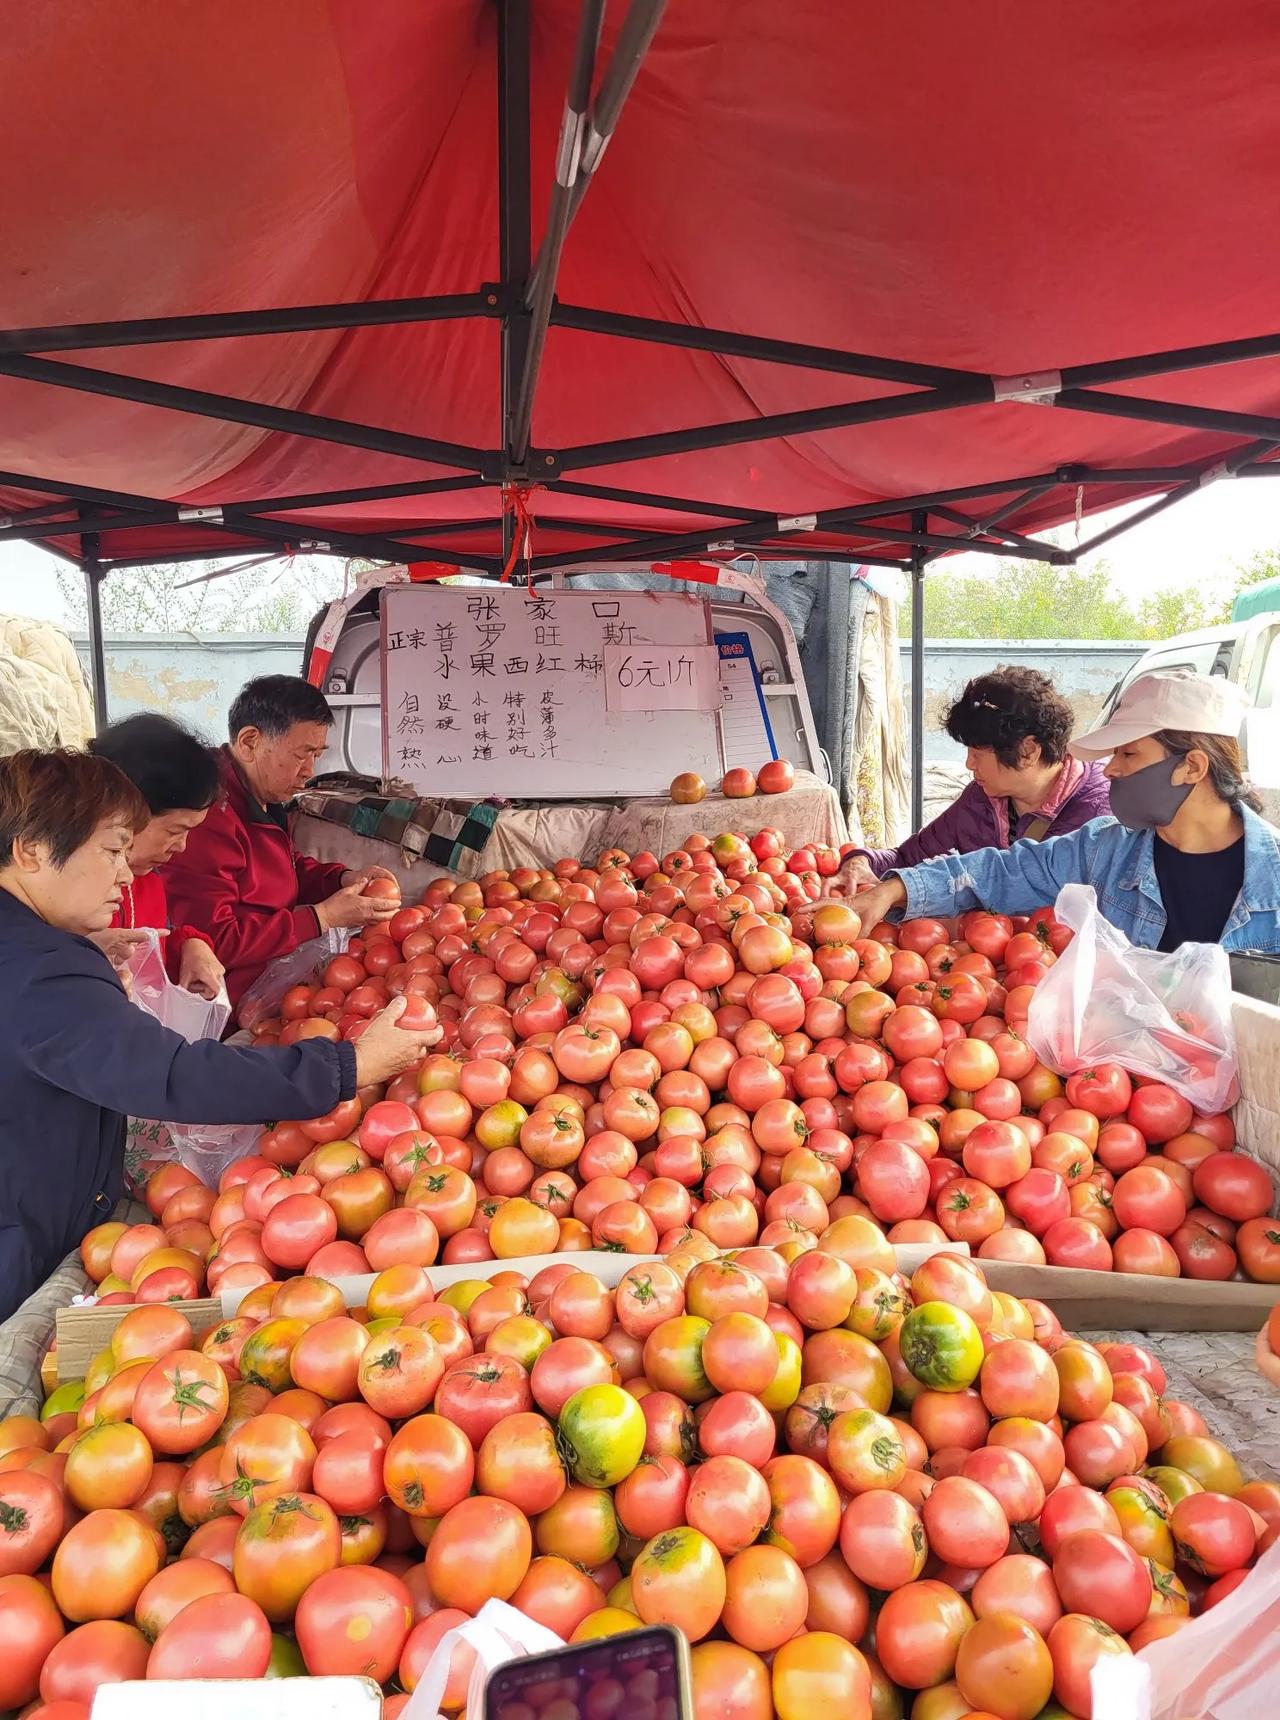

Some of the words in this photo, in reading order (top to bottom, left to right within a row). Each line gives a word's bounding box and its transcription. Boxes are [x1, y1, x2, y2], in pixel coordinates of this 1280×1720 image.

[467, 596, 620, 621] 张家口
[433, 653, 603, 680] 水果西红柿
[472, 691, 499, 762] 小时味道
[502, 691, 535, 759] 特别好吃
